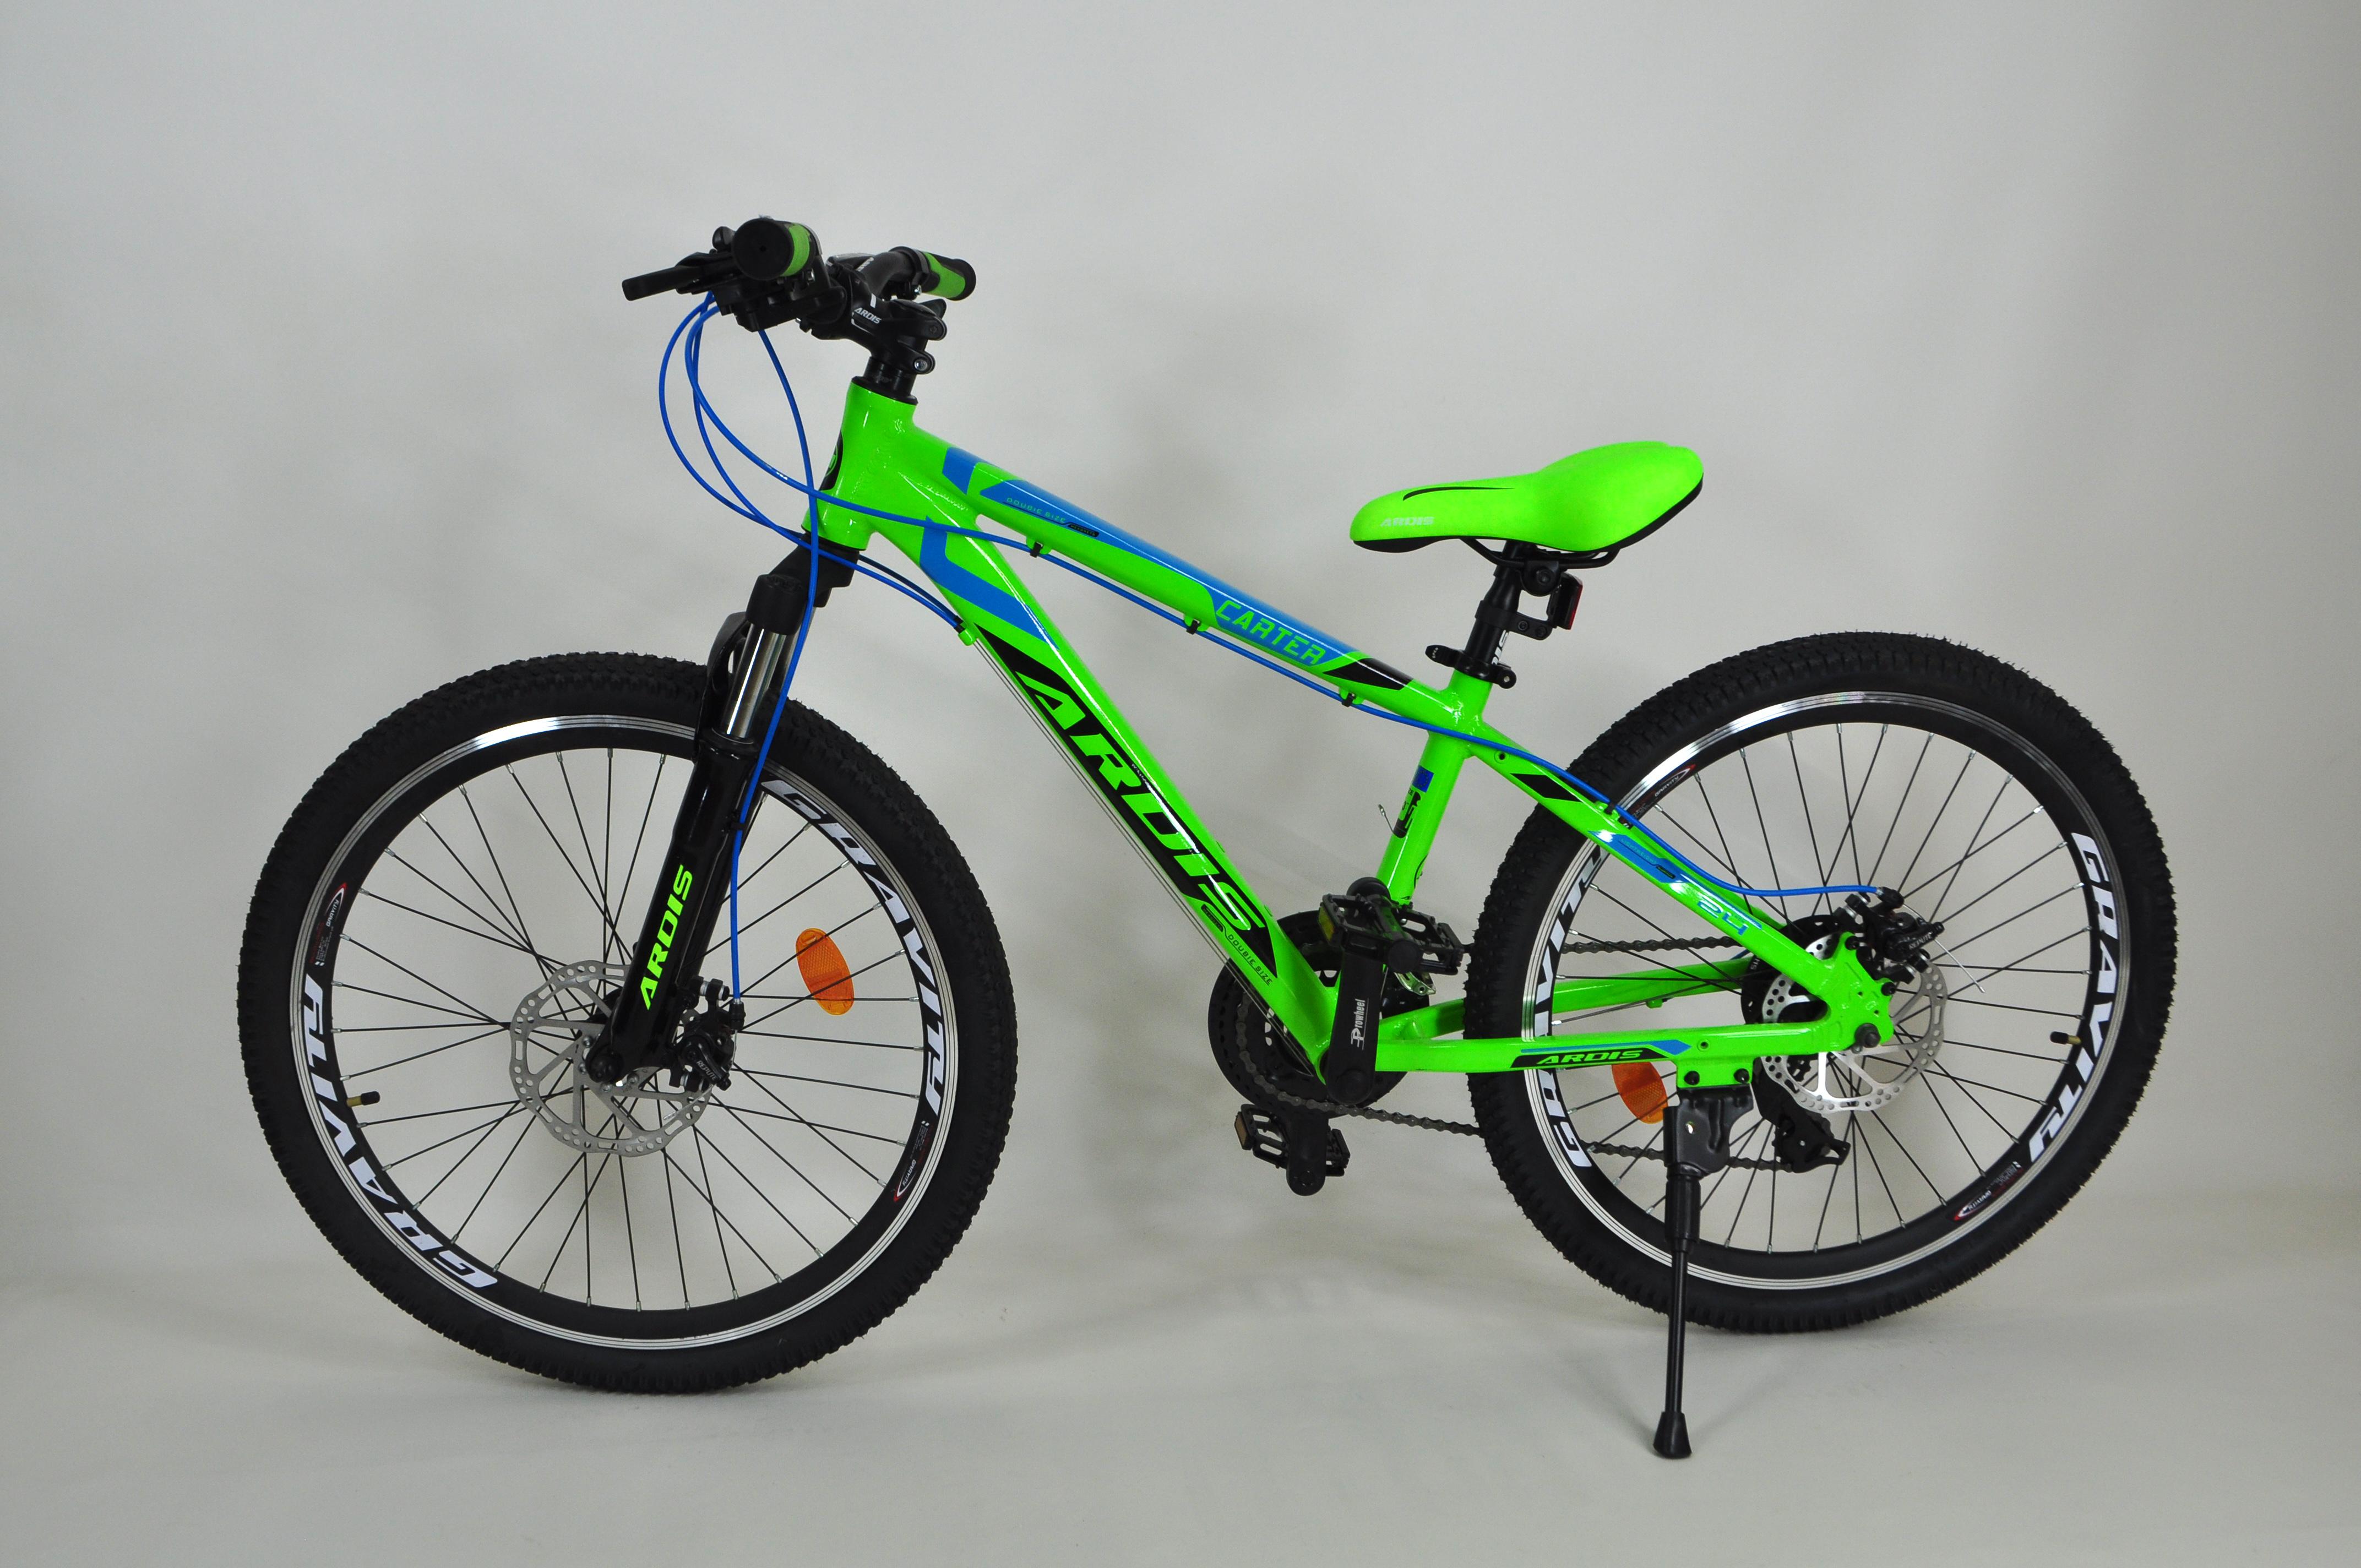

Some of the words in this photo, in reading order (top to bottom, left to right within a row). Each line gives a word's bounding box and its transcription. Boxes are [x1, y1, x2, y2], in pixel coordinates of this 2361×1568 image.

[854, 307, 882, 324] ARDIS
[1380, 516, 1435, 527] ARDIS
[1215, 600, 1326, 665] CARTER
[1014, 671, 1266, 930] ARDIS
[1654, 776, 1679, 797] GRAVITY
[326, 899, 340, 927] GRAVITY
[640, 864, 693, 1010] ARDIS
[761, 780, 942, 1116] GRAVITY
[1255, 965, 1273, 984] SIZE
[2028, 832, 2118, 1163] GRAVITY
[1351, 998, 1367, 1049] Prowheel
[696, 1060, 717, 1081] REPUTE
[1536, 1049, 1644, 1065] ARDIS
[303, 973, 498, 1288] GRAVITY
[901, 1159, 916, 1186] GRAVITY
